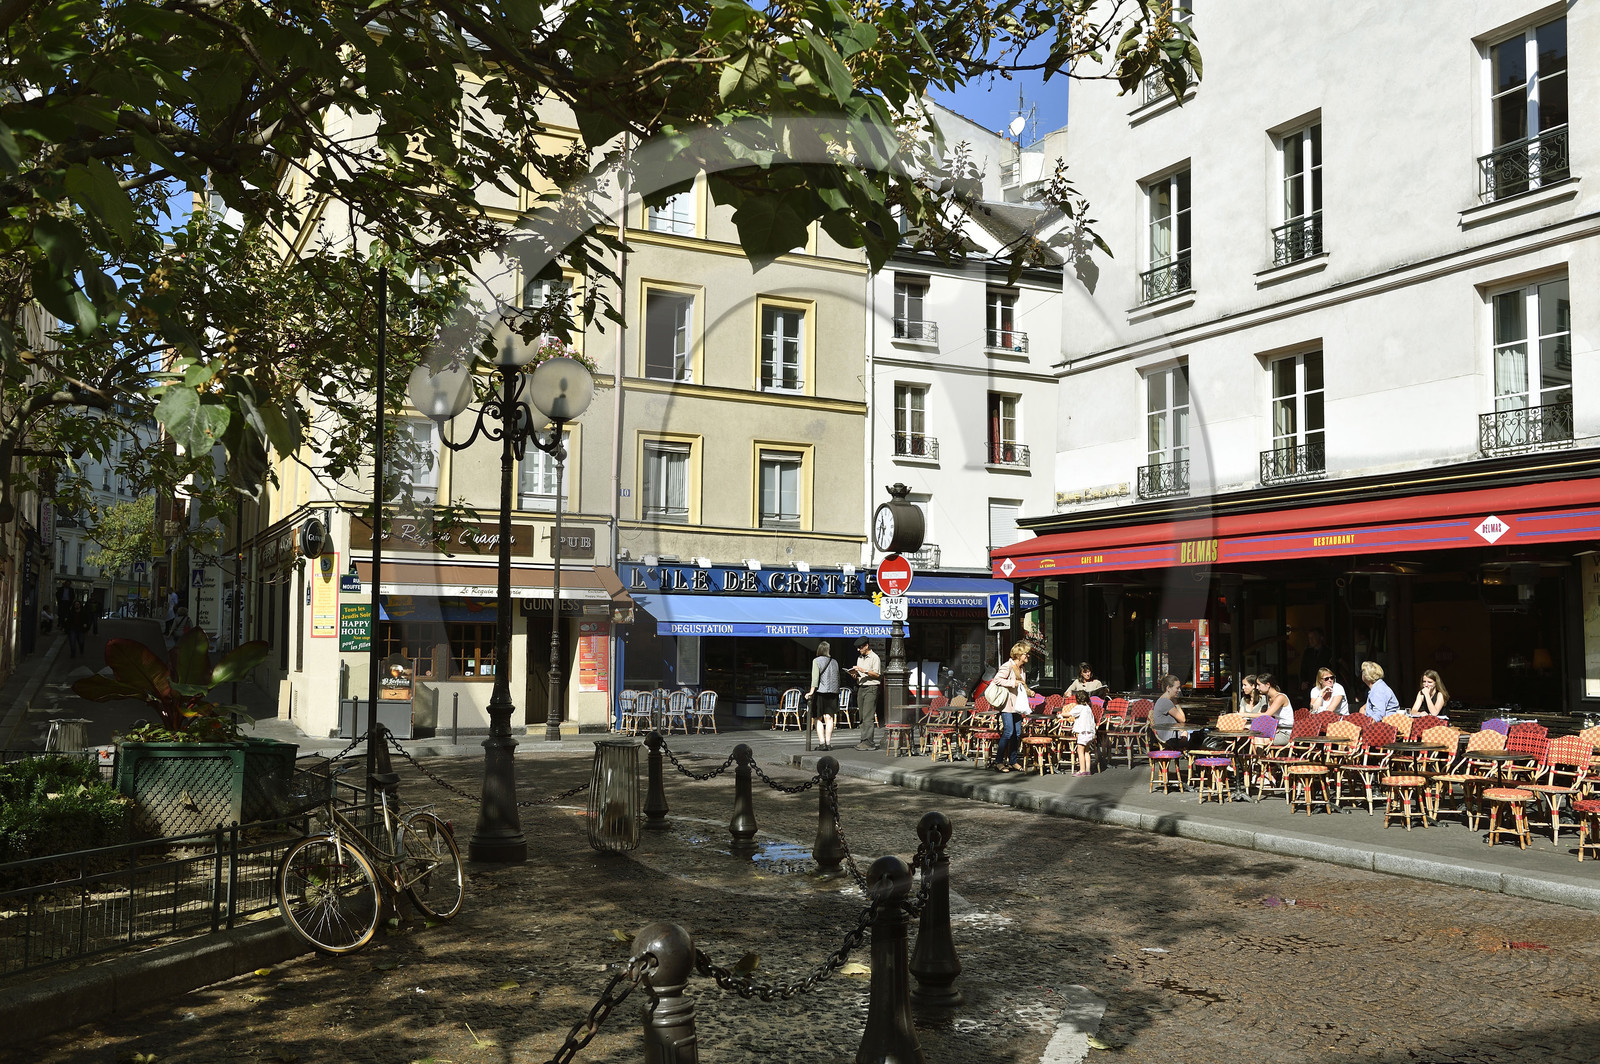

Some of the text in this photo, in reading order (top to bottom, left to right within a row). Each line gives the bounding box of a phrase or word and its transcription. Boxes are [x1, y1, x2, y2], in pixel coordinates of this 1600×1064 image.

[621, 488, 630, 497] 10
[1482, 523, 1502, 534] DELMAS
[401, 523, 451, 547] Reqin
[1313, 534, 1355, 547] RESTAURANT
[1180, 539, 1219, 564] DELMAS
[1081, 555, 1103, 565] CAFE BAR
[723, 570, 758, 592] DE
[768, 572, 859, 595] CRETE
[523, 599, 580, 611] GUINESS
[907, 597, 983, 606] TRAITEUR ASIATIQUE
[342, 620, 370, 628] HAPPY
[671, 624, 734, 634] DEGUSTATION
[765, 625, 809, 635] TRAITEUR
